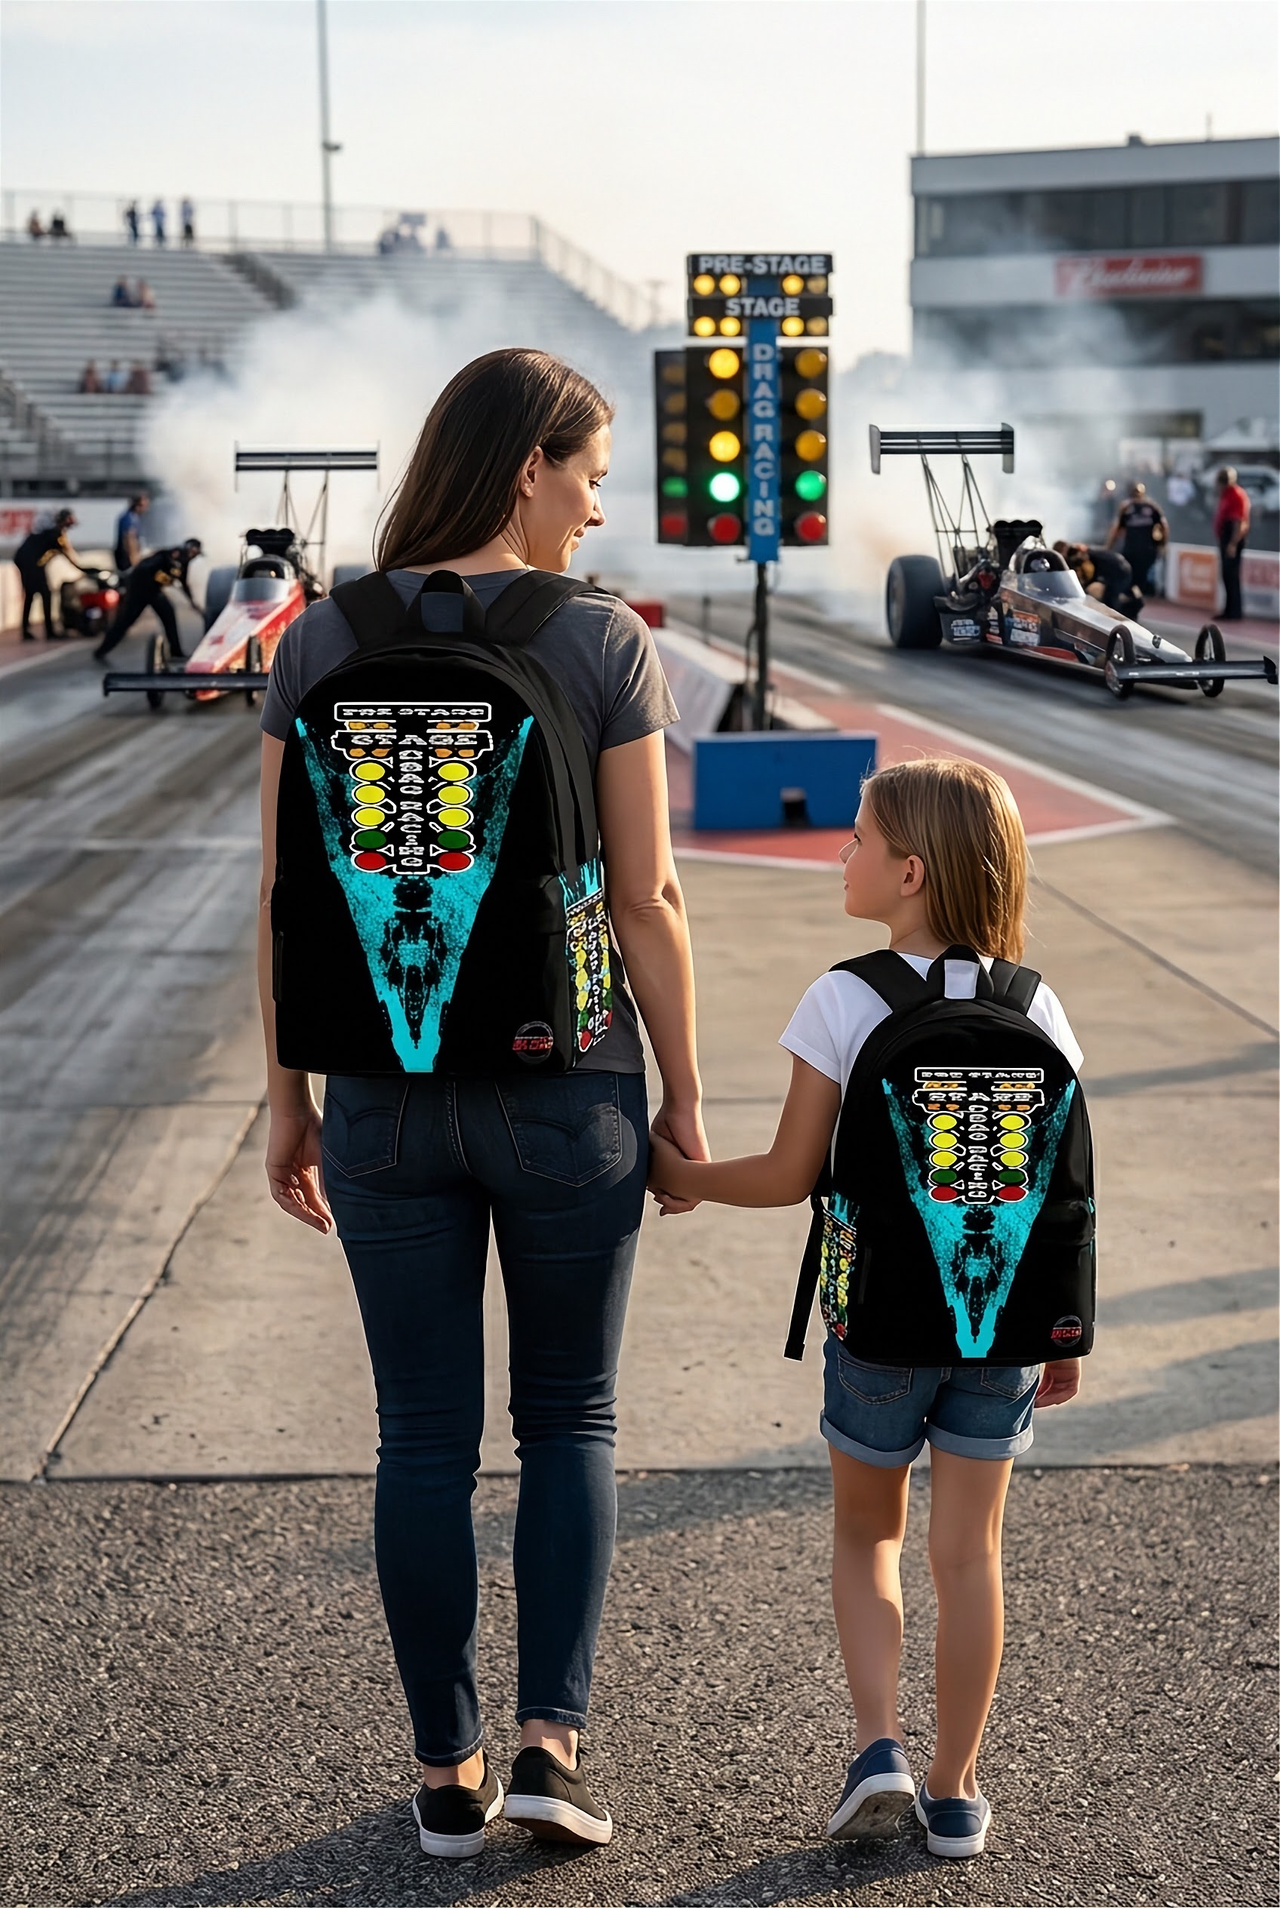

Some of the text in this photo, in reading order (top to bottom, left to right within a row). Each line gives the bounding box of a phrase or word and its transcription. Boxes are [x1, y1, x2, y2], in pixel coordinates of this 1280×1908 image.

[698, 254, 827, 275] PRE-STAGE
[725, 297, 801, 317] STAGE
[752, 423, 776, 536] RACING
